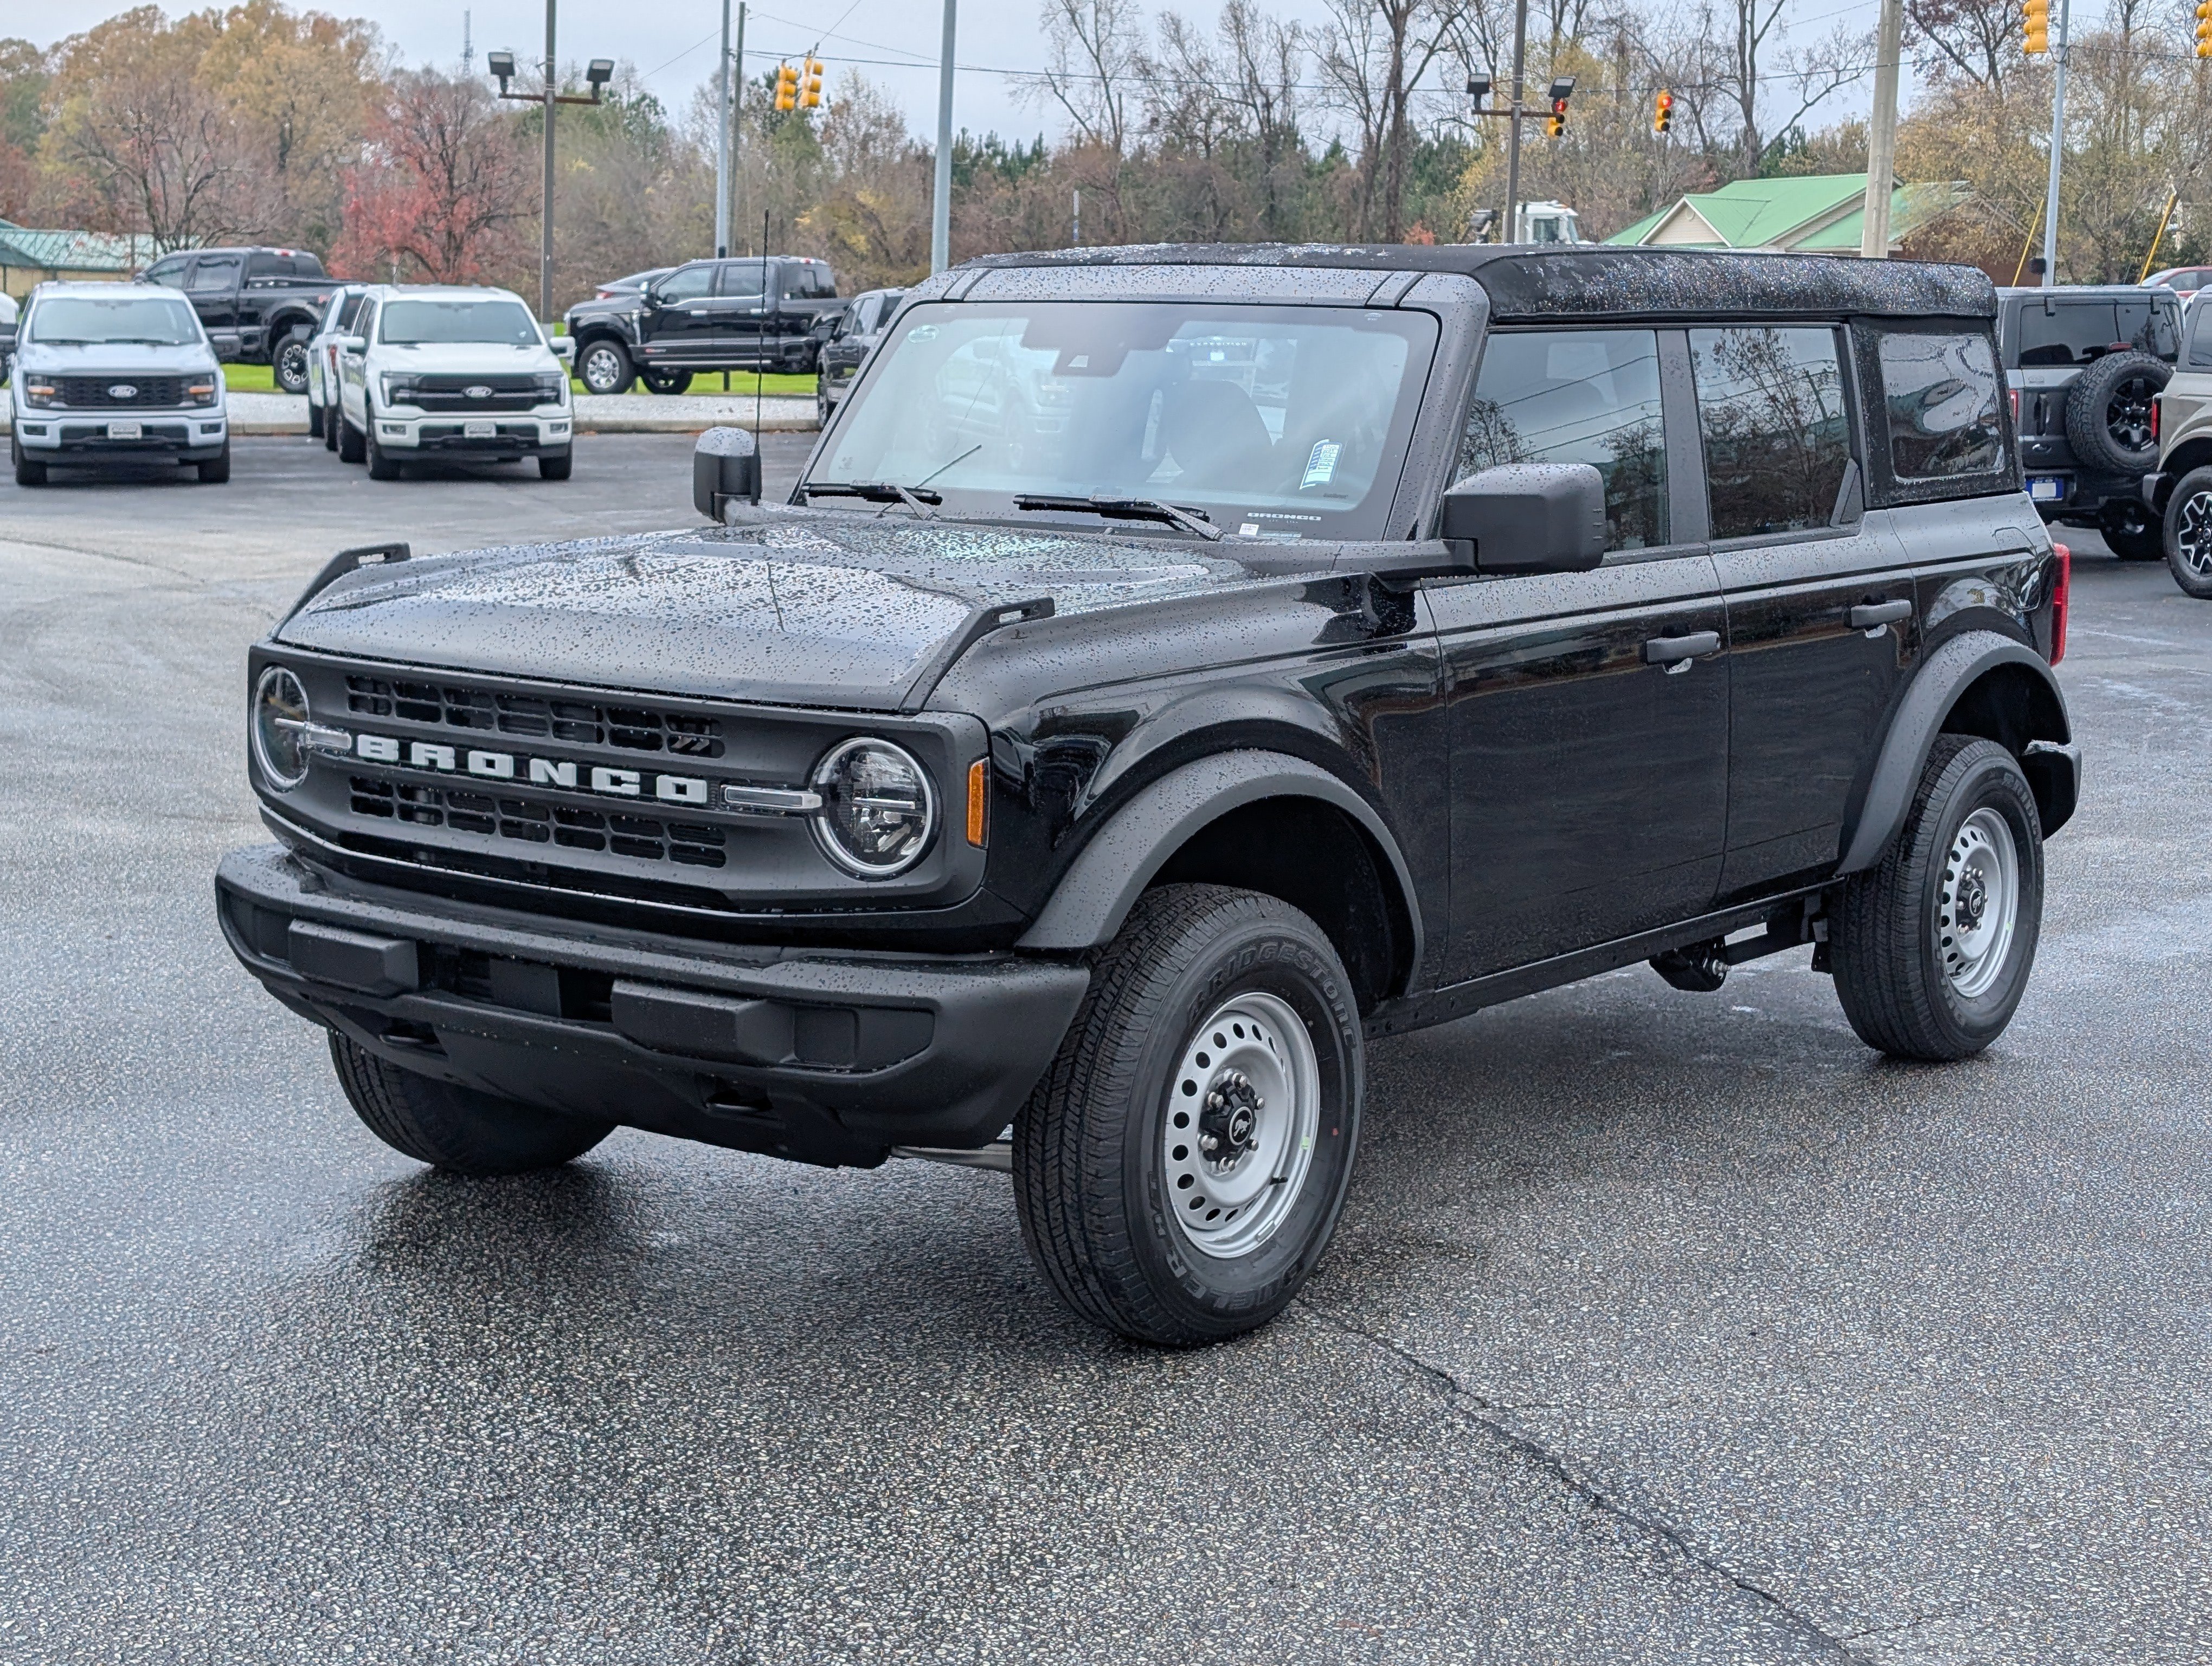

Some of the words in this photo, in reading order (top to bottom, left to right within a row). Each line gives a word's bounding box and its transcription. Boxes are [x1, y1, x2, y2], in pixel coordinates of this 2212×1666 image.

[1248, 512, 1321, 521] BRONCO
[358, 734, 706, 803] BRONCO
[1188, 941, 1356, 1047] BRIDGESTONE
